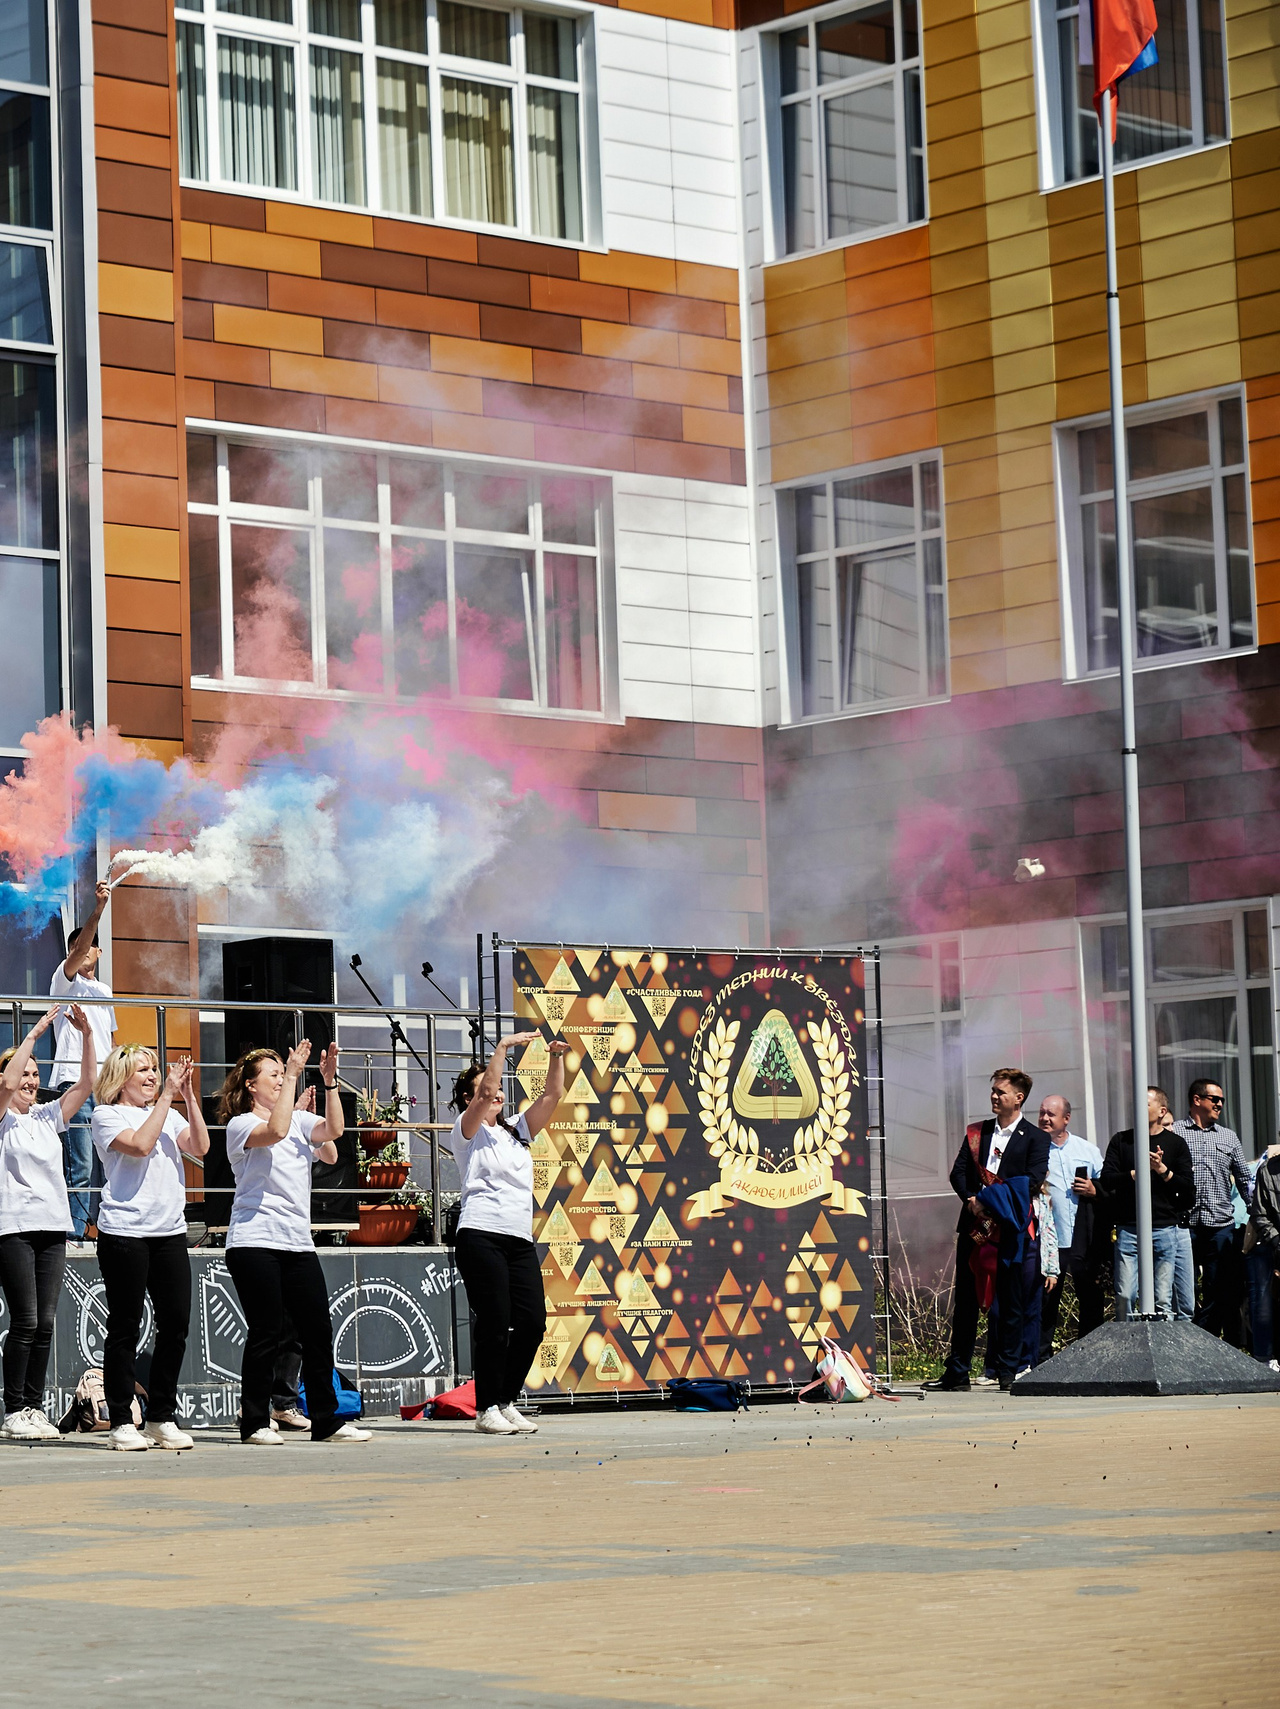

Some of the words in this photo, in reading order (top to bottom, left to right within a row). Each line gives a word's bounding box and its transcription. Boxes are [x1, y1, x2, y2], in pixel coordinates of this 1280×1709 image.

[517, 986, 545, 994] #СПОРТ
[626, 988, 681, 997] #СЧАСТЛИВЫЕ
[683, 989, 703, 998] ГОДА
[688, 1002, 716, 1086] ЧЕРЕЗ
[790, 972, 804, 984] К
[549, 1121, 618, 1131] #АКАДЕМЛИЦЕЙ
[731, 1174, 823, 1200] АКАДЕМЛИЦЕЙ
[569, 1206, 617, 1214] #ТВОРЧЕСТВО
[630, 1240, 642, 1248] #ЗА
[662, 1239, 693, 1247] БУДУЩЕЕ
